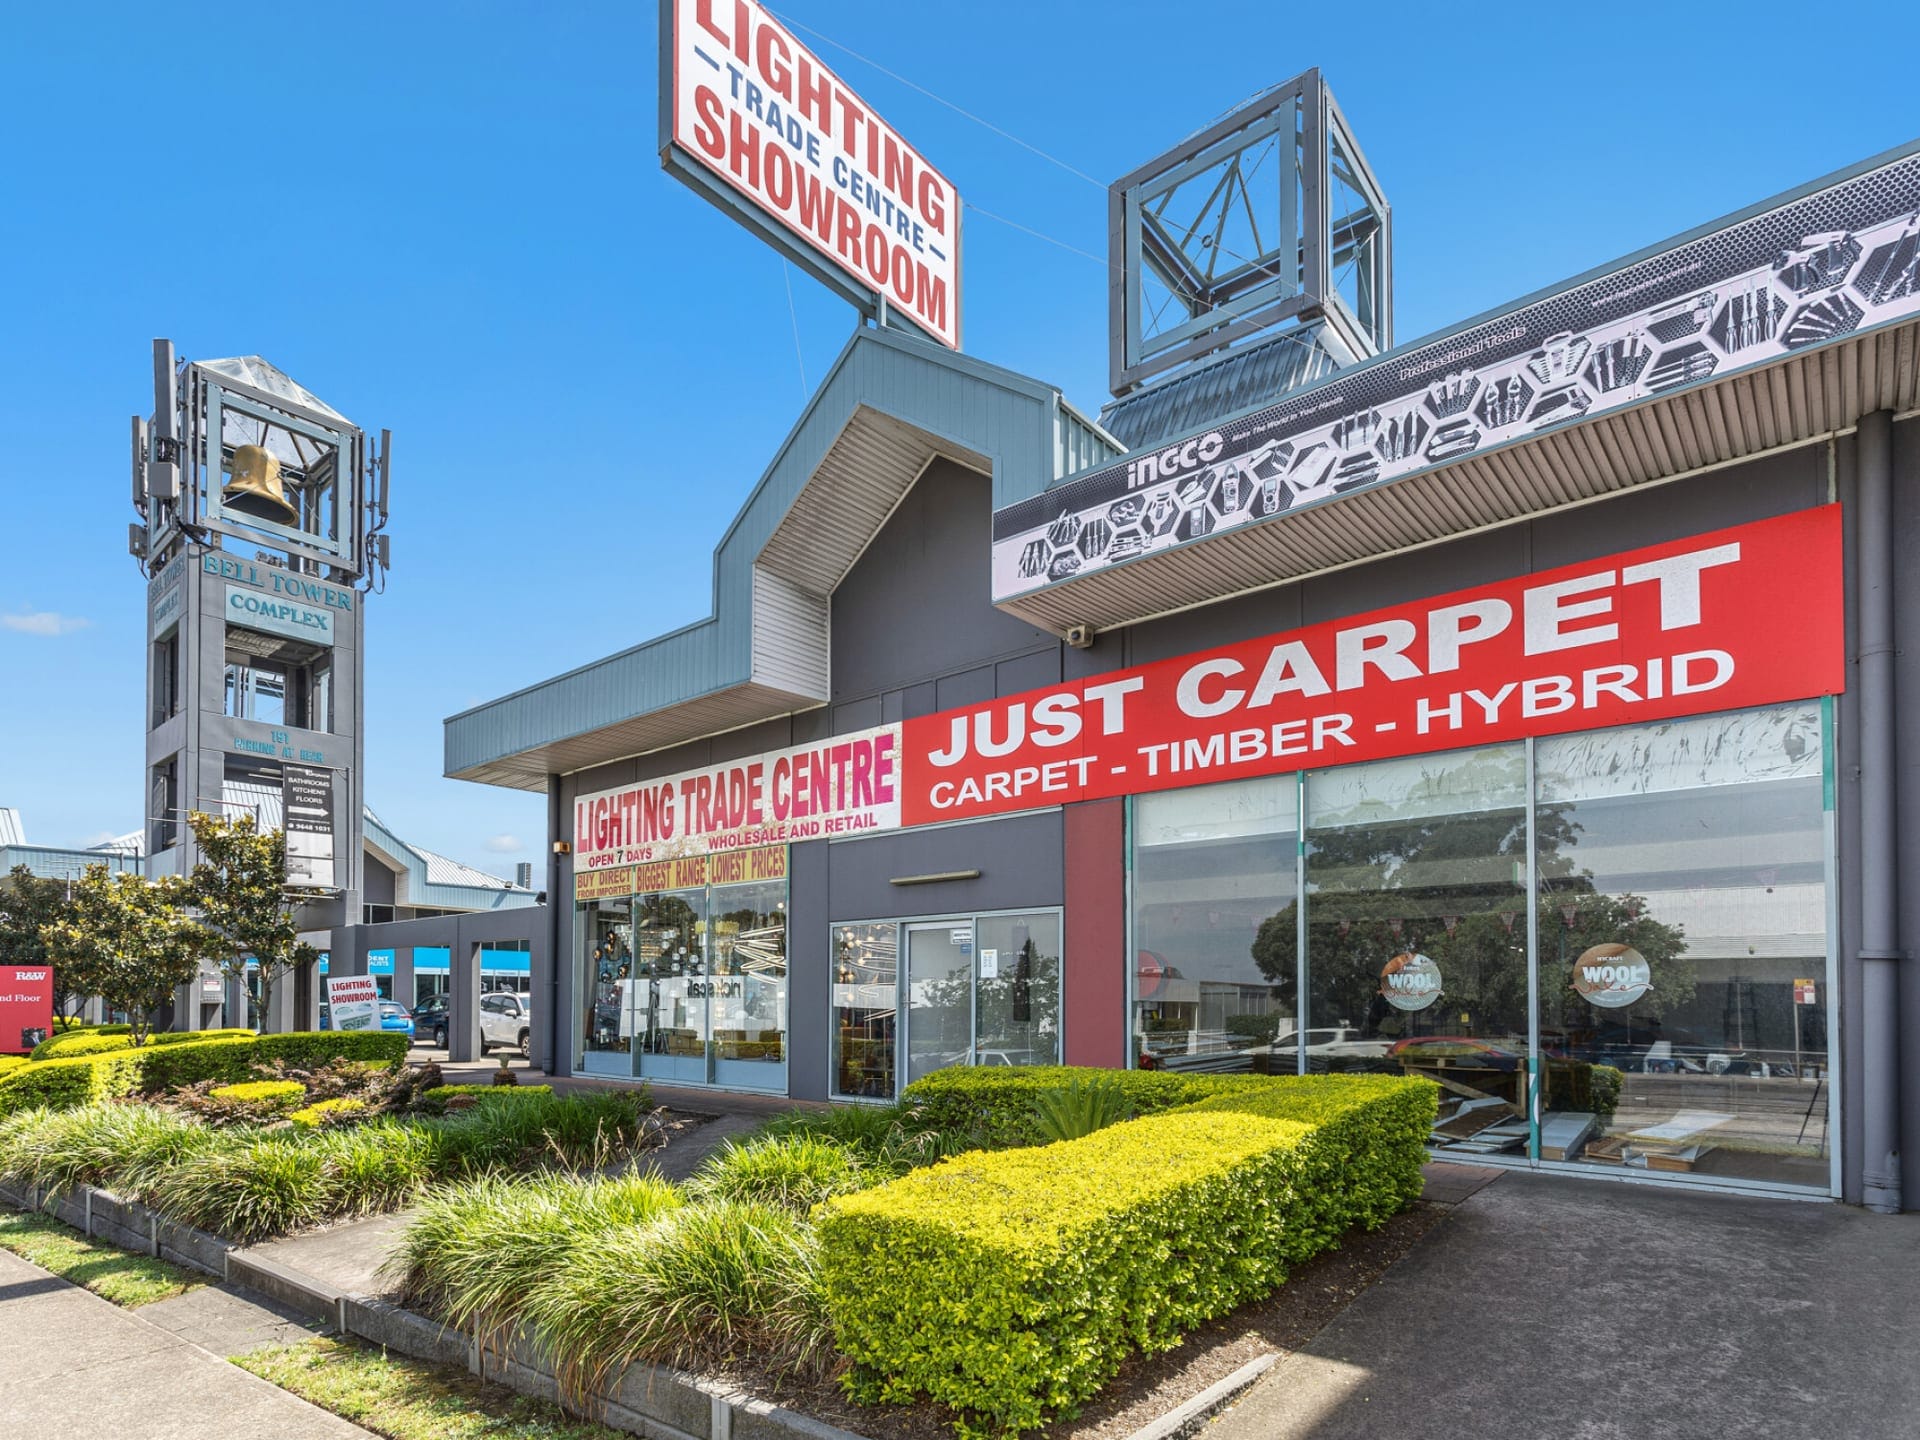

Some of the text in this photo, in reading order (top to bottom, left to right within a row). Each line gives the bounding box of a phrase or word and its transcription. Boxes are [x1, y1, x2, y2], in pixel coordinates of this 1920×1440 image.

[726, 62, 924, 253] TRADE CENTRE
[694, 85, 946, 332] SHOWROOM
[1400, 327, 1526, 380] Professional Tools
[1253, 425, 1266, 434] The
[1267, 416, 1289, 429] World
[1300, 406, 1318, 416] Your
[203, 555, 264, 587] BELL
[270, 571, 352, 611] TOWER
[231, 594, 328, 630] COMPLEX
[929, 542, 1741, 766] JUST CARPET
[929, 755, 1098, 809] CARPET
[1137, 712, 1354, 777] TIMBER
[1417, 648, 1736, 735] HYBRID
[234, 738, 276, 755] PARKING
[282, 747, 294, 758] AT
[576, 733, 894, 854] LIGHTING TRADE CENTRE
[708, 812, 878, 850] WHOLESALE AND RETAIL
[589, 847, 652, 868] OPEN 7 DAYS
[711, 846, 785, 883] LOWEST PRICES
[577, 868, 631, 888] BUY DIRECT
[636, 856, 705, 892] BIGGEST RANGE
[577, 885, 631, 898] FROM IMPORTER
[16, 971, 46, 981] R&W
[331, 980, 372, 991] LIGHTING
[1387, 973, 1436, 989] WOOL
[1582, 966, 1642, 983] WOOL
[15, 994, 41, 1002] Floor
[331, 992, 377, 1004] SHOWROOM
